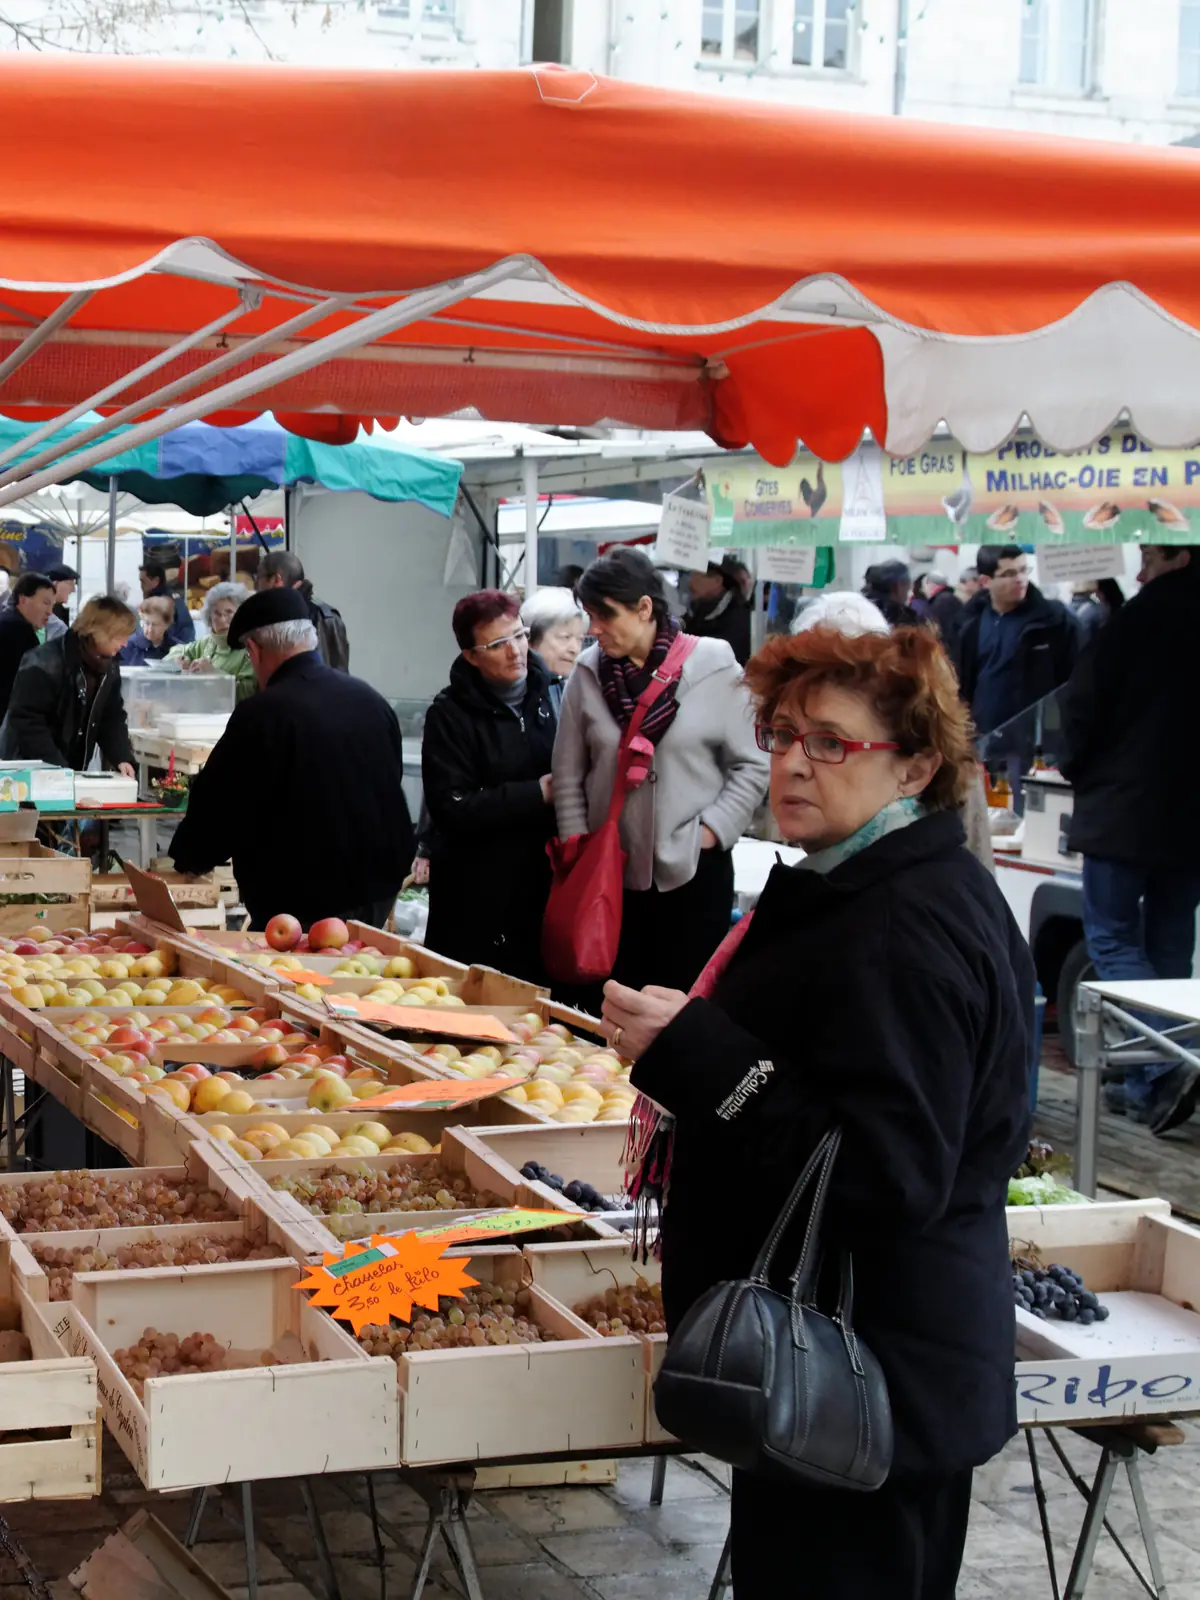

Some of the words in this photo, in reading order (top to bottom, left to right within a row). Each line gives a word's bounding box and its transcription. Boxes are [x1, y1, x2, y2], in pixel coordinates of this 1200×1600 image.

[921, 452, 955, 474] GRAS
[1133, 467, 1168, 487] EN
[721, 1071, 768, 1121] Columbia
[388, 1281, 402, 1296] le
